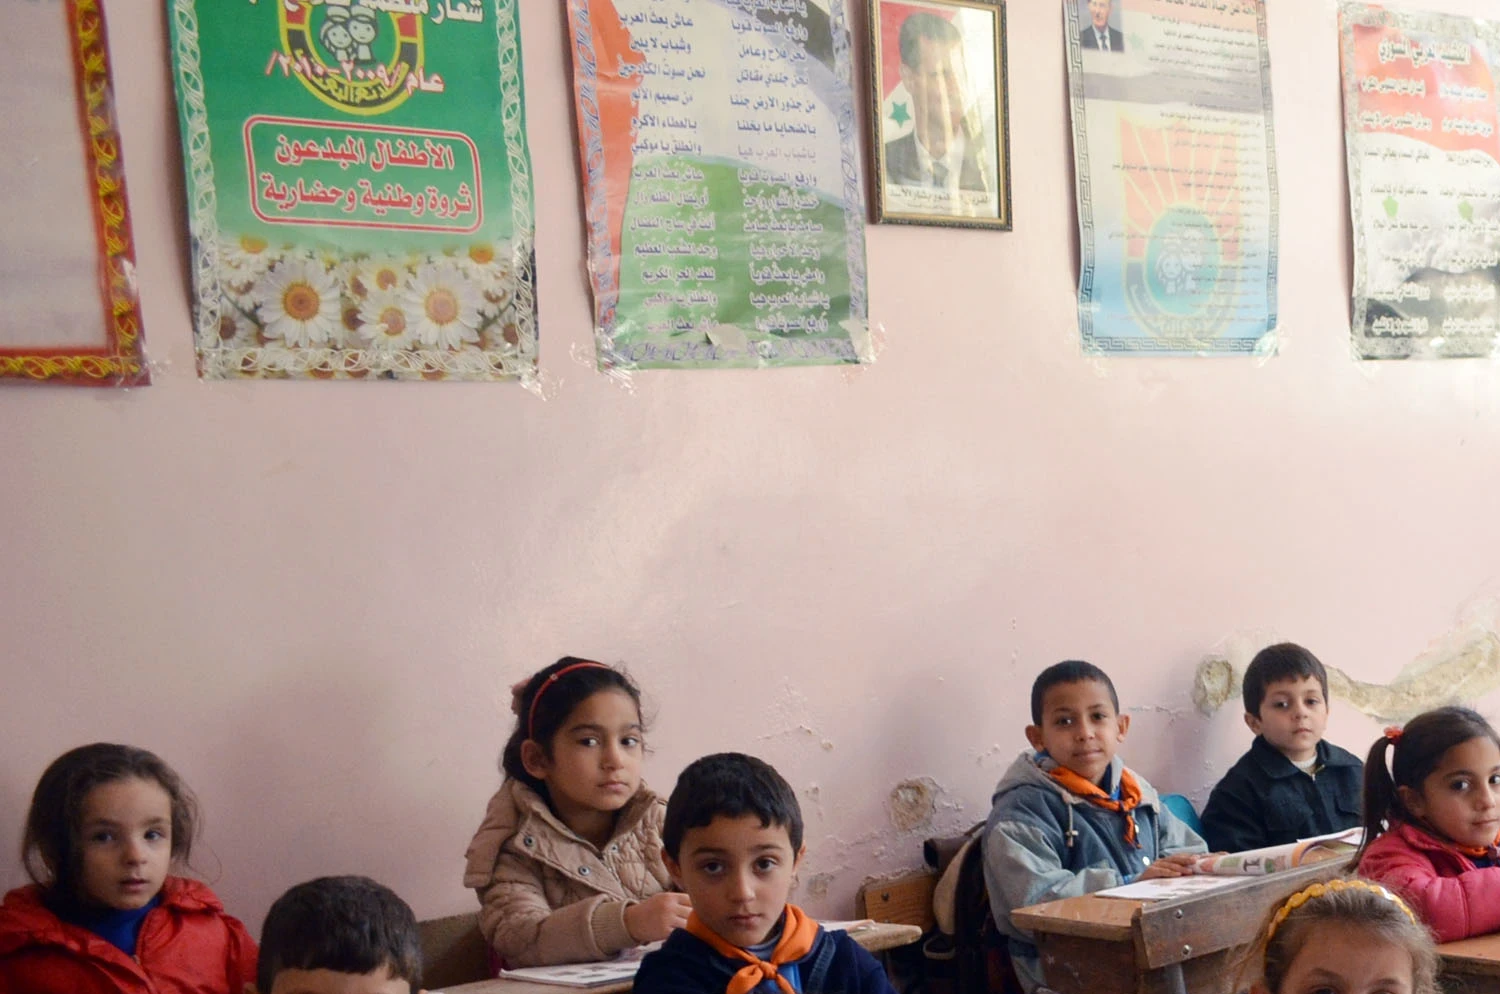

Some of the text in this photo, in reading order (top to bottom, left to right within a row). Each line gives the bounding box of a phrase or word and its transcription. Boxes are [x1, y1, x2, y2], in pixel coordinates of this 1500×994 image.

[407, 66, 445, 96] عام
[276, 134, 455, 170] الأطفال المبدعون
[360, 178, 425, 215] وطنية
[428, 182, 473, 217] ثروة
